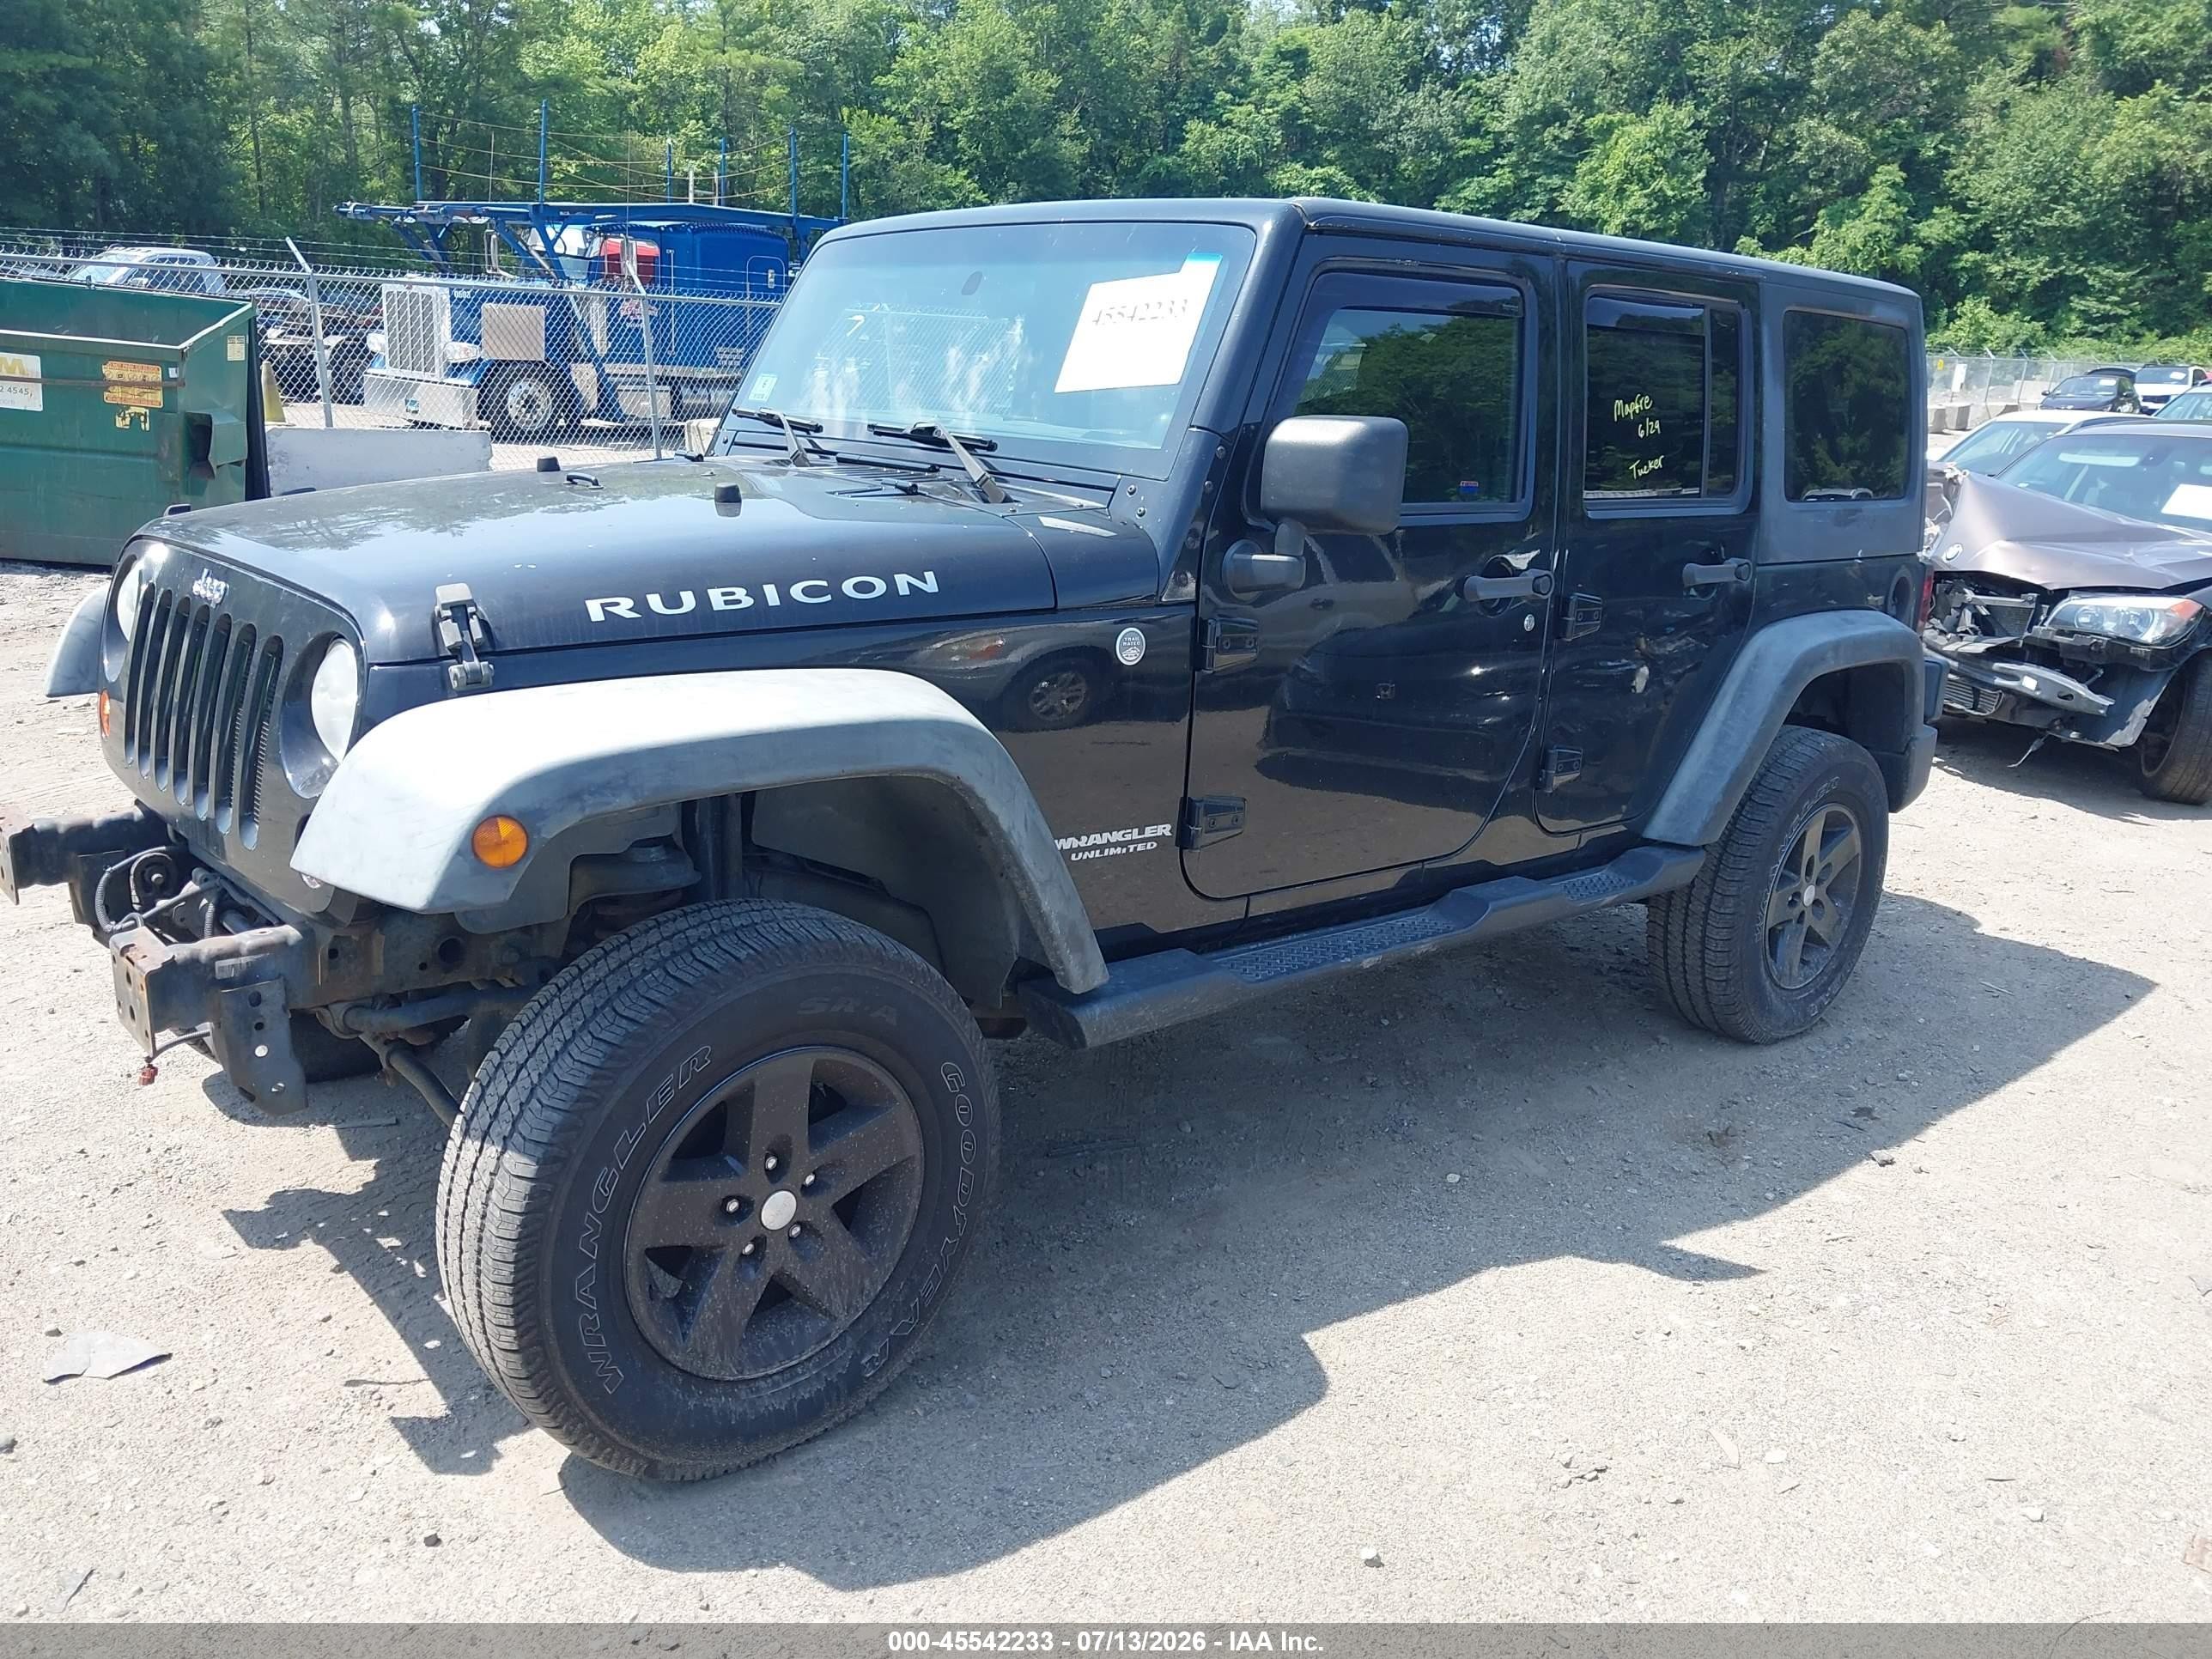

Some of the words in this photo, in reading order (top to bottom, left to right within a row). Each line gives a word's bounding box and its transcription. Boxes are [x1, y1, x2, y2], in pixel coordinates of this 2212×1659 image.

[1614, 393, 1653, 422] Mapfre
[1638, 417, 1661, 439] 6/29
[584, 570, 939, 623] RUBICON
[1054, 823, 1173, 851] WRANGLER
[575, 1045, 712, 1395] WRANGLER
